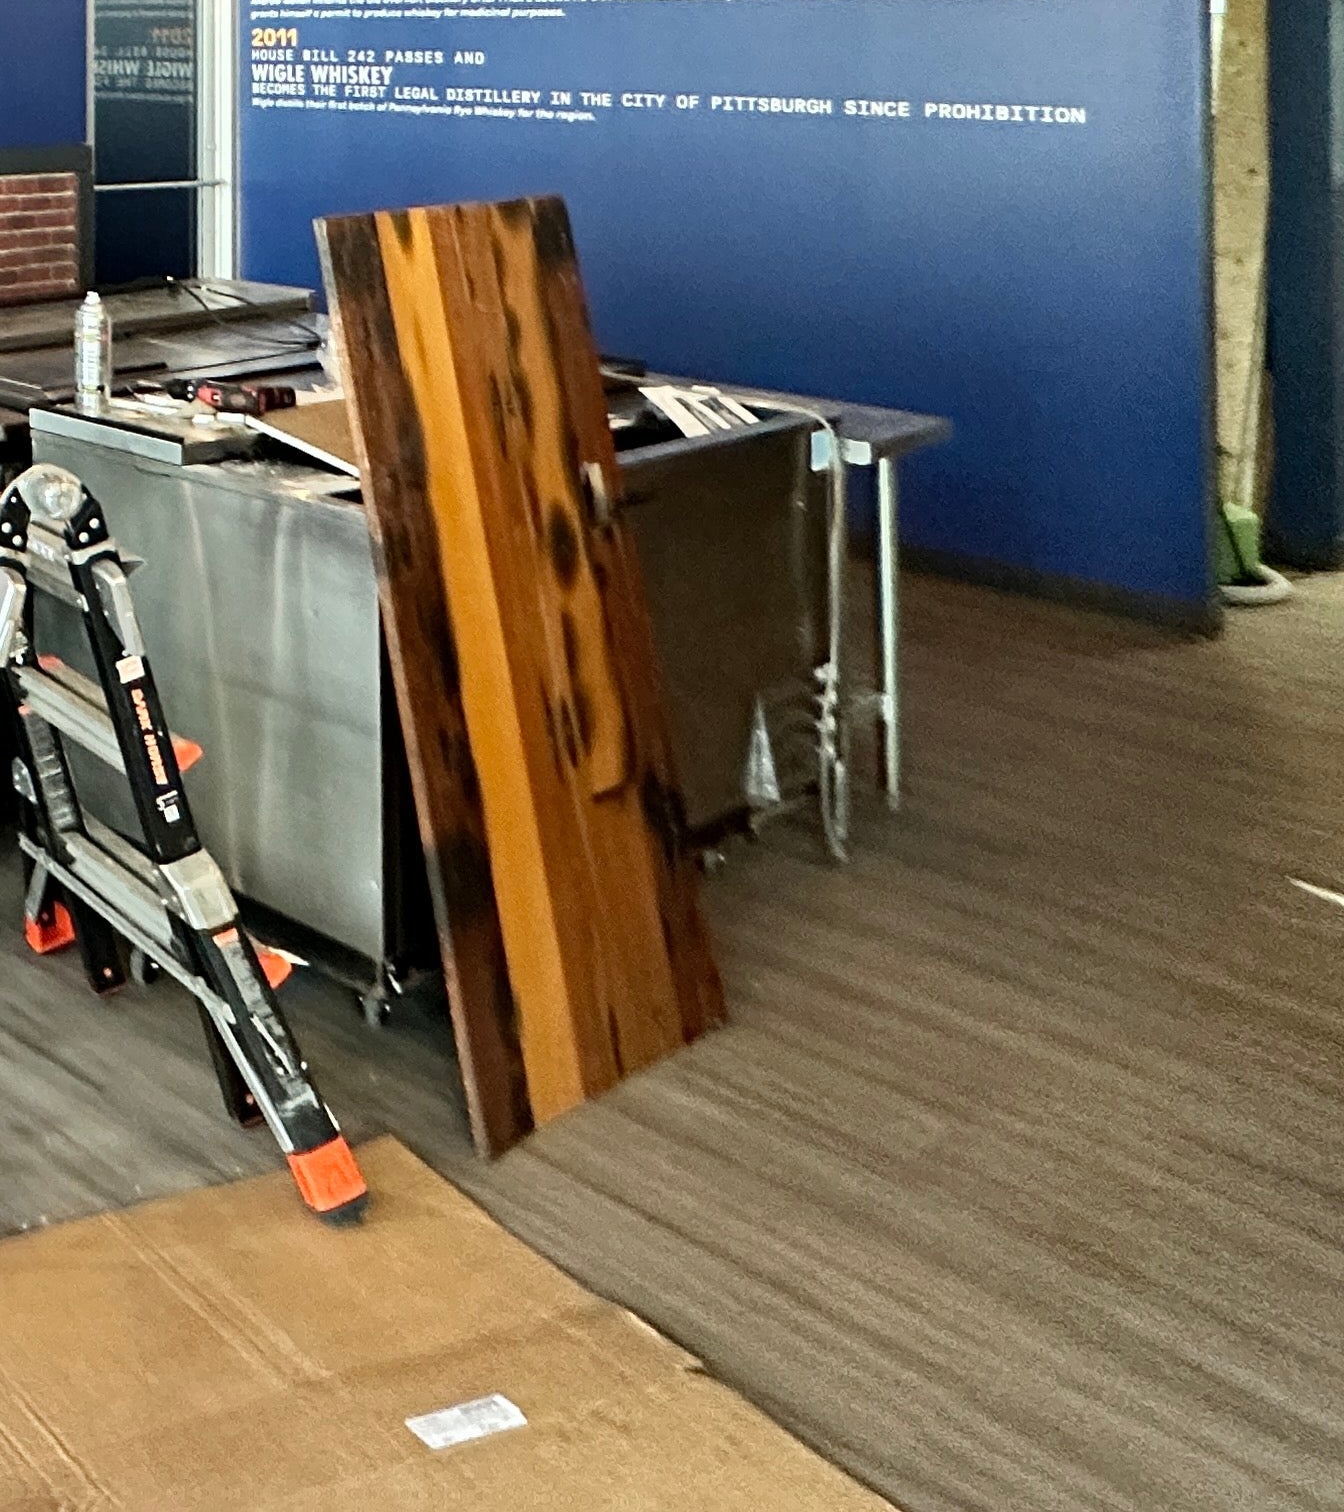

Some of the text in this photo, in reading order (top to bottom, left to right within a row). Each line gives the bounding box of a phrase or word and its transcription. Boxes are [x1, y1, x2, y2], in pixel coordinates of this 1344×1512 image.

[251, 27, 297, 47] 2011
[251, 48, 485, 65] HOUSE BILL 242 PASSES AND
[251, 63, 393, 85] WIGLE WHISKEY
[251, 82, 1086, 124] BECOMES THE FIRST LEGAL DISTILLERY IN THE CITY OF PITTSBURGH SINCE PROHIBITION
